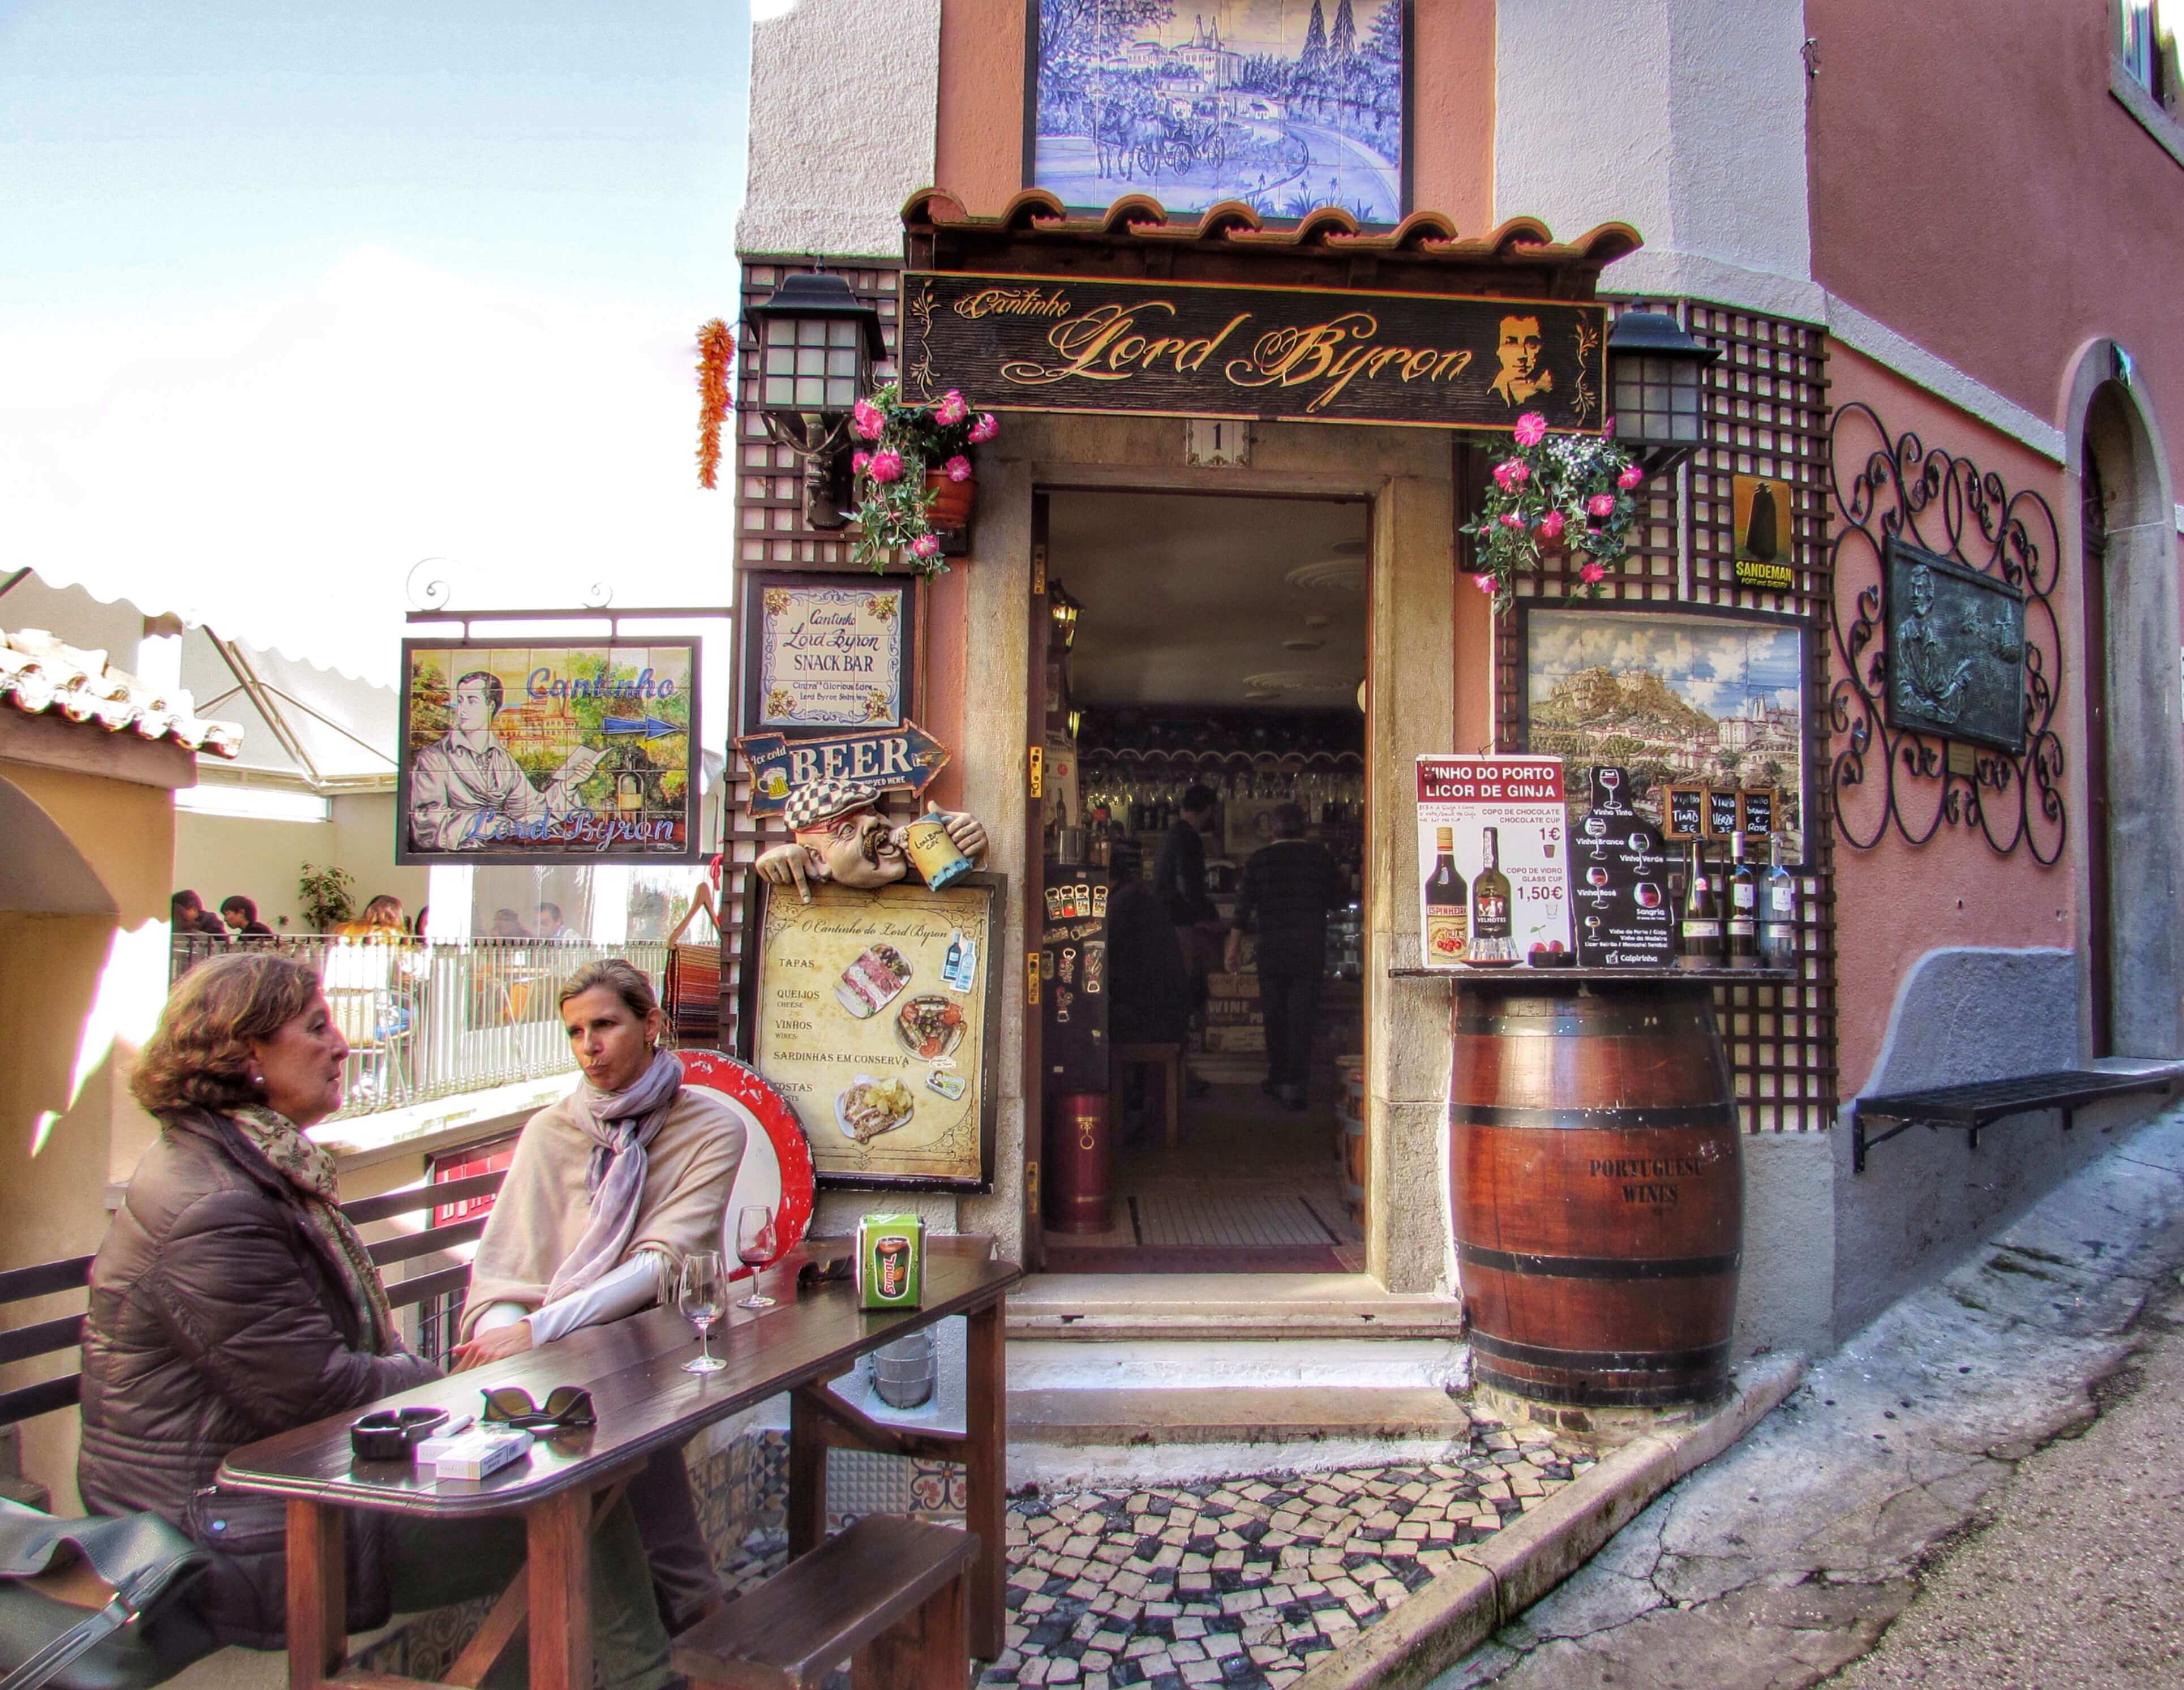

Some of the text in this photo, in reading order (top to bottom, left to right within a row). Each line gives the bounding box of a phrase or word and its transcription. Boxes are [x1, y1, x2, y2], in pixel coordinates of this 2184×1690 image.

[954, 287, 1072, 320] Cantinho
[1000, 300, 1473, 413] Lord Byron
[1213, 422, 1222, 451] 1
[1736, 561, 1792, 581] SANDEMAN
[1767, 580, 1788, 589] SHERRY
[809, 609, 856, 626] Cantinho
[783, 623, 881, 653] Lord Byron
[794, 654, 874, 672] SNACK BAR
[526, 667, 679, 700] Cantinho
[751, 745, 787, 766] Ice cold
[789, 737, 913, 786] BEER
[887, 776, 906, 784] HERE
[1476, 767, 1498, 779] DO
[1503, 767, 1555, 780] PORTO
[1426, 785, 1556, 797] LICOR DE GINJA
[466, 807, 675, 852] Lord Byron
[1539, 827, 1560, 840] 1€
[1517, 886, 1563, 902] 1,50€
[814, 919, 863, 934] Cantinho
[864, 923, 876, 934] do
[879, 923, 910, 936] Lord
[909, 924, 947, 947] Byron
[779, 959, 815, 969] TAPAS
[778, 990, 820, 1000] QUEIJOS
[775, 1020, 813, 1031] VINHOS
[774, 1052, 910, 1066] SARDINHAS EM CONSERVA
[1622, 1185, 1679, 1204] WINES
